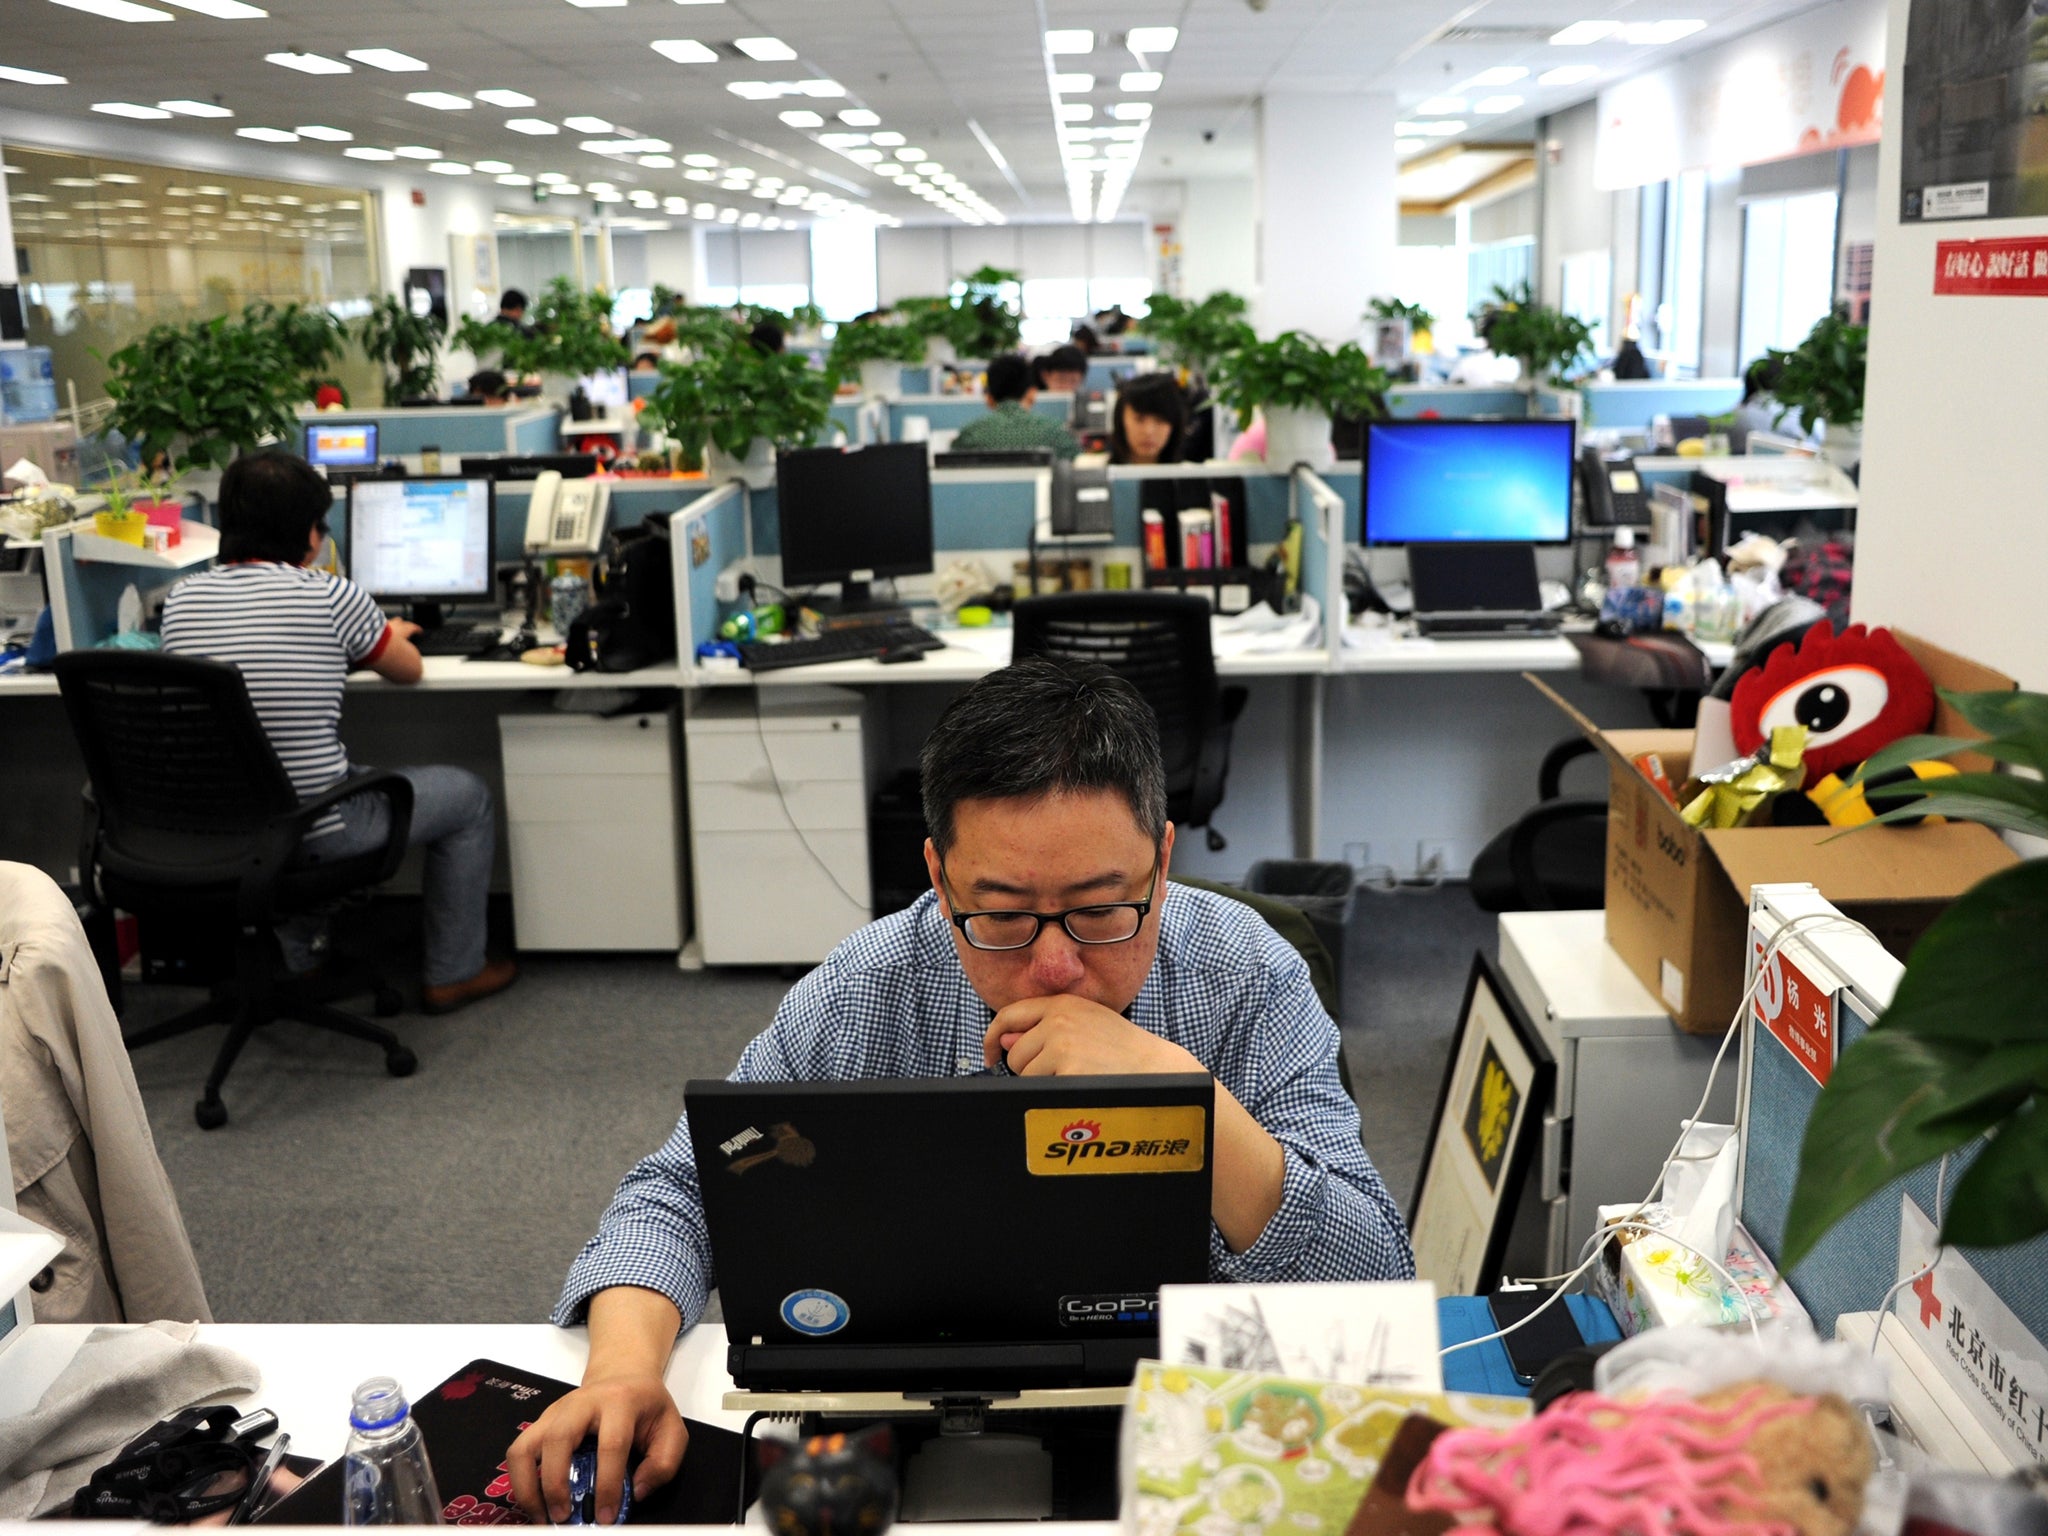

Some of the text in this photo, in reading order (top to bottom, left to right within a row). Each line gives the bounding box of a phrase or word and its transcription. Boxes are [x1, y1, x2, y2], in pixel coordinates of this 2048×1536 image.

[1044, 1138, 1190, 1166] sina 新浪
[1066, 1298, 1159, 1313] GoPr
[1945, 1338, 2039, 1460] Red Cross Society of China
